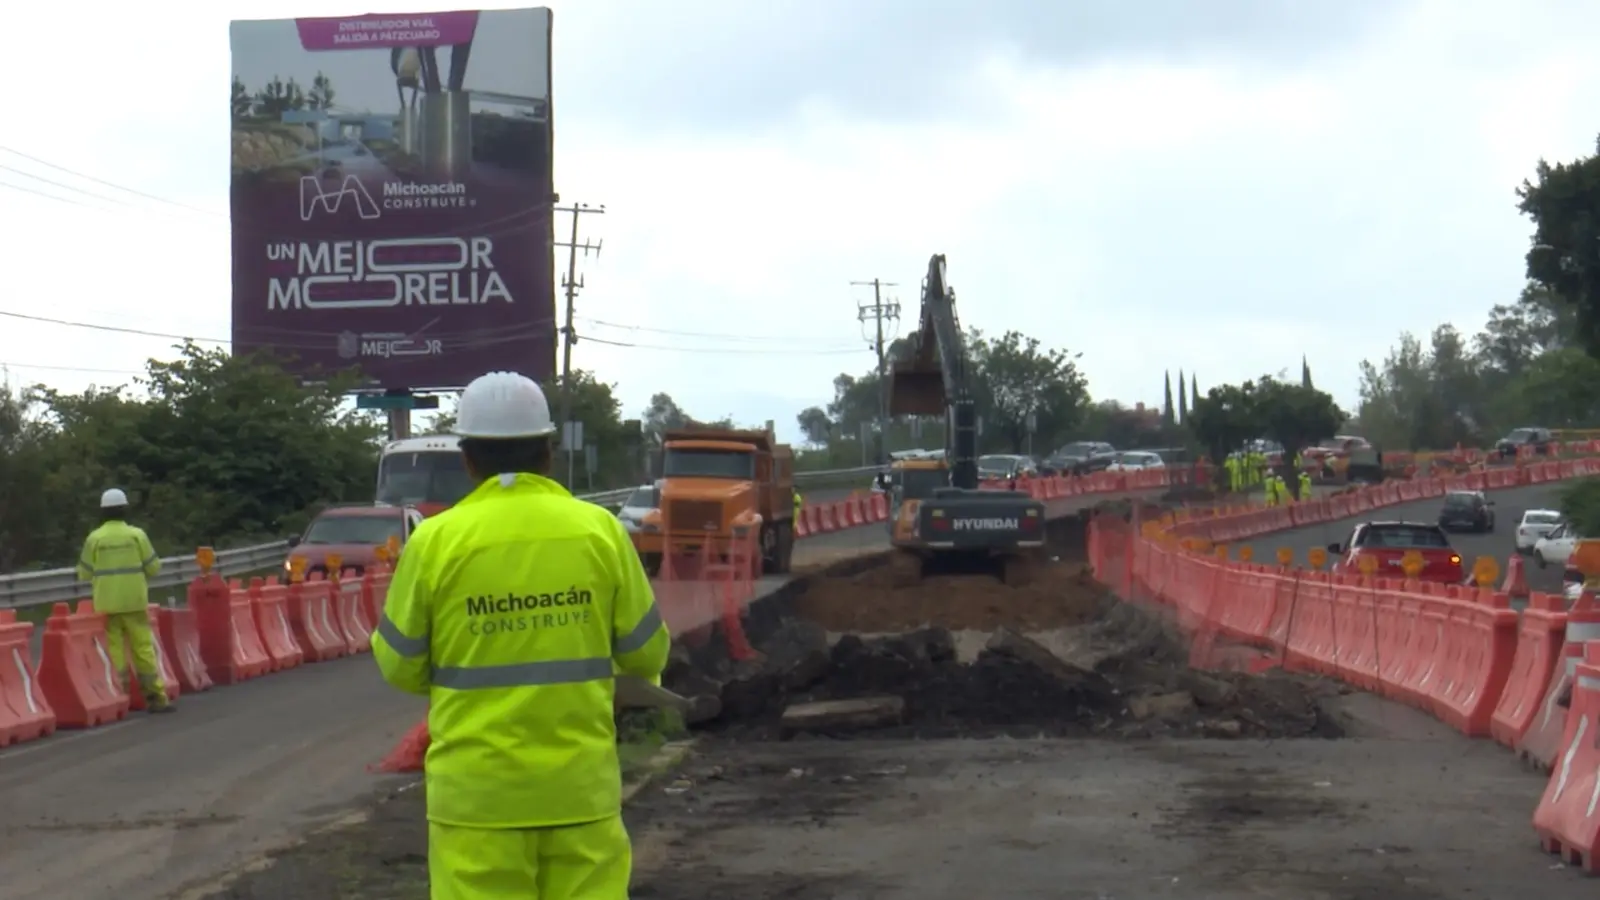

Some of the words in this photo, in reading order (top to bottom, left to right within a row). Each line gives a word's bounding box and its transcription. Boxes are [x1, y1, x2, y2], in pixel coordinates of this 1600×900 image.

[339, 19, 410, 32] DISTRIBUIDOR
[412, 18, 435, 28] VIAL
[333, 31, 370, 44] SALIDA
[370, 31, 378, 41] A
[383, 181, 466, 196] Michoacán
[383, 196, 466, 209] CONSTRUYE
[267, 243, 296, 260] UN
[298, 237, 494, 281] MEJOR
[267, 271, 514, 309] MORELIA
[953, 517, 1019, 531] HYUNDAI
[466, 584, 592, 617] Michoacán
[468, 609, 591, 637] CONSTRUYE
